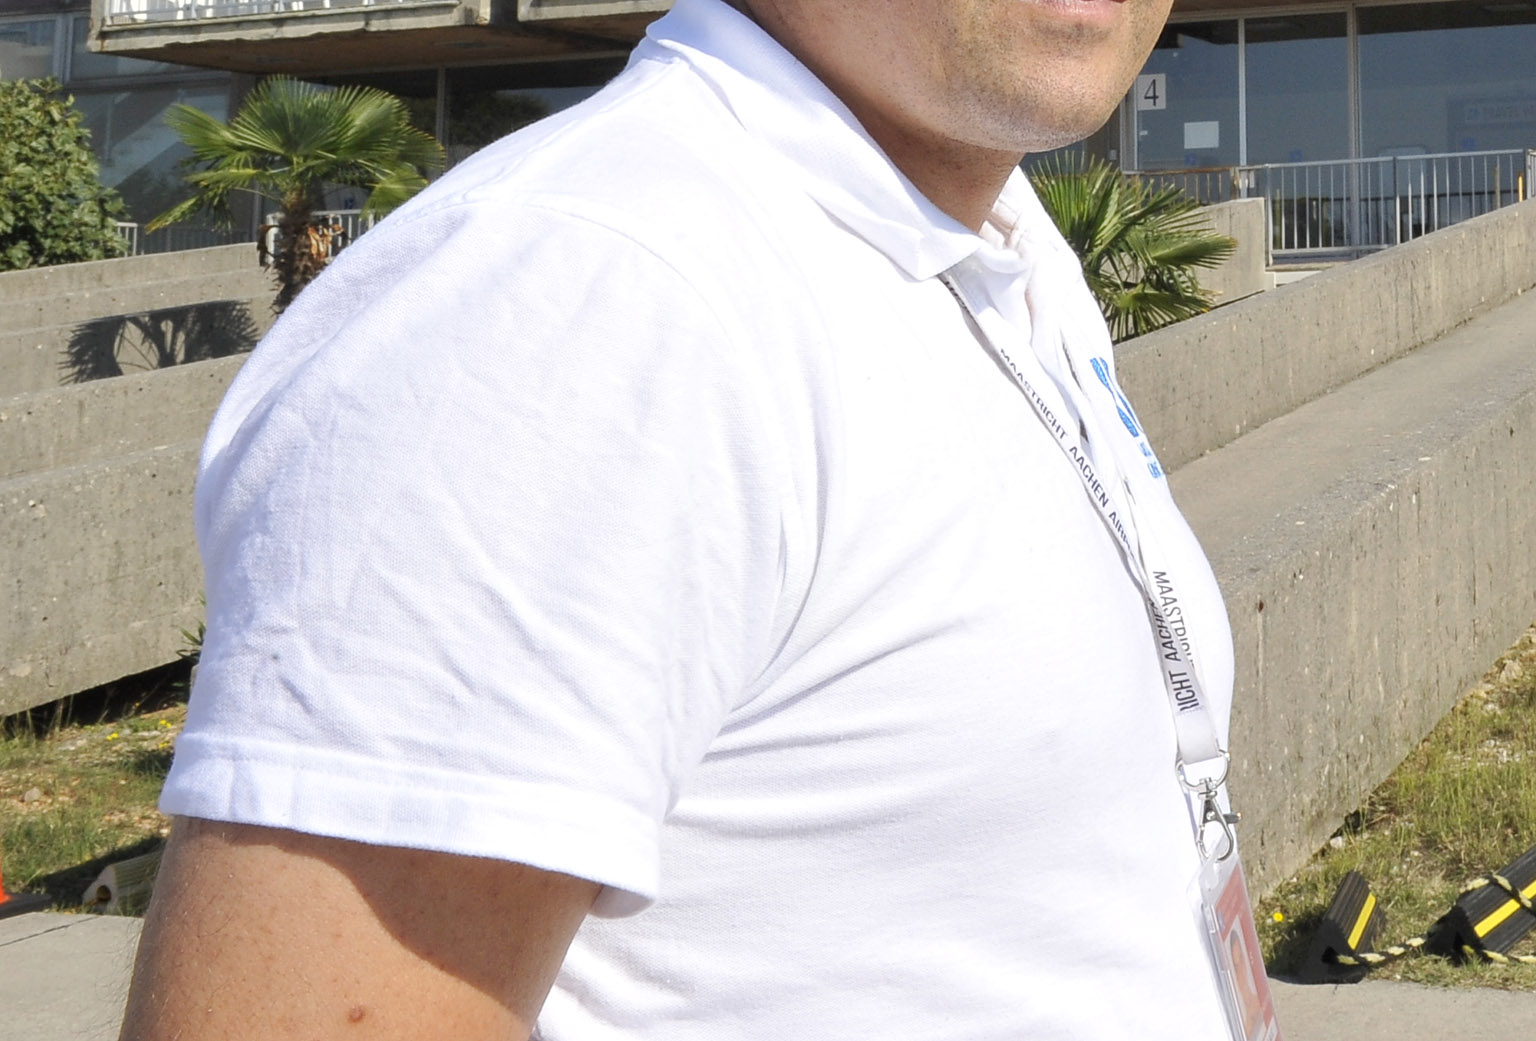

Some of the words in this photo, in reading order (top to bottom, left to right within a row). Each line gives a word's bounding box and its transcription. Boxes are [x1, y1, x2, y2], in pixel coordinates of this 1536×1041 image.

[1144, 78, 1159, 107] 4
[1000, 347, 1069, 440] MAASTRICHT
[1069, 446, 1110, 508] AACHEN
[1108, 511, 1135, 560] AIRP
[1153, 570, 1195, 668] MAASTRI
